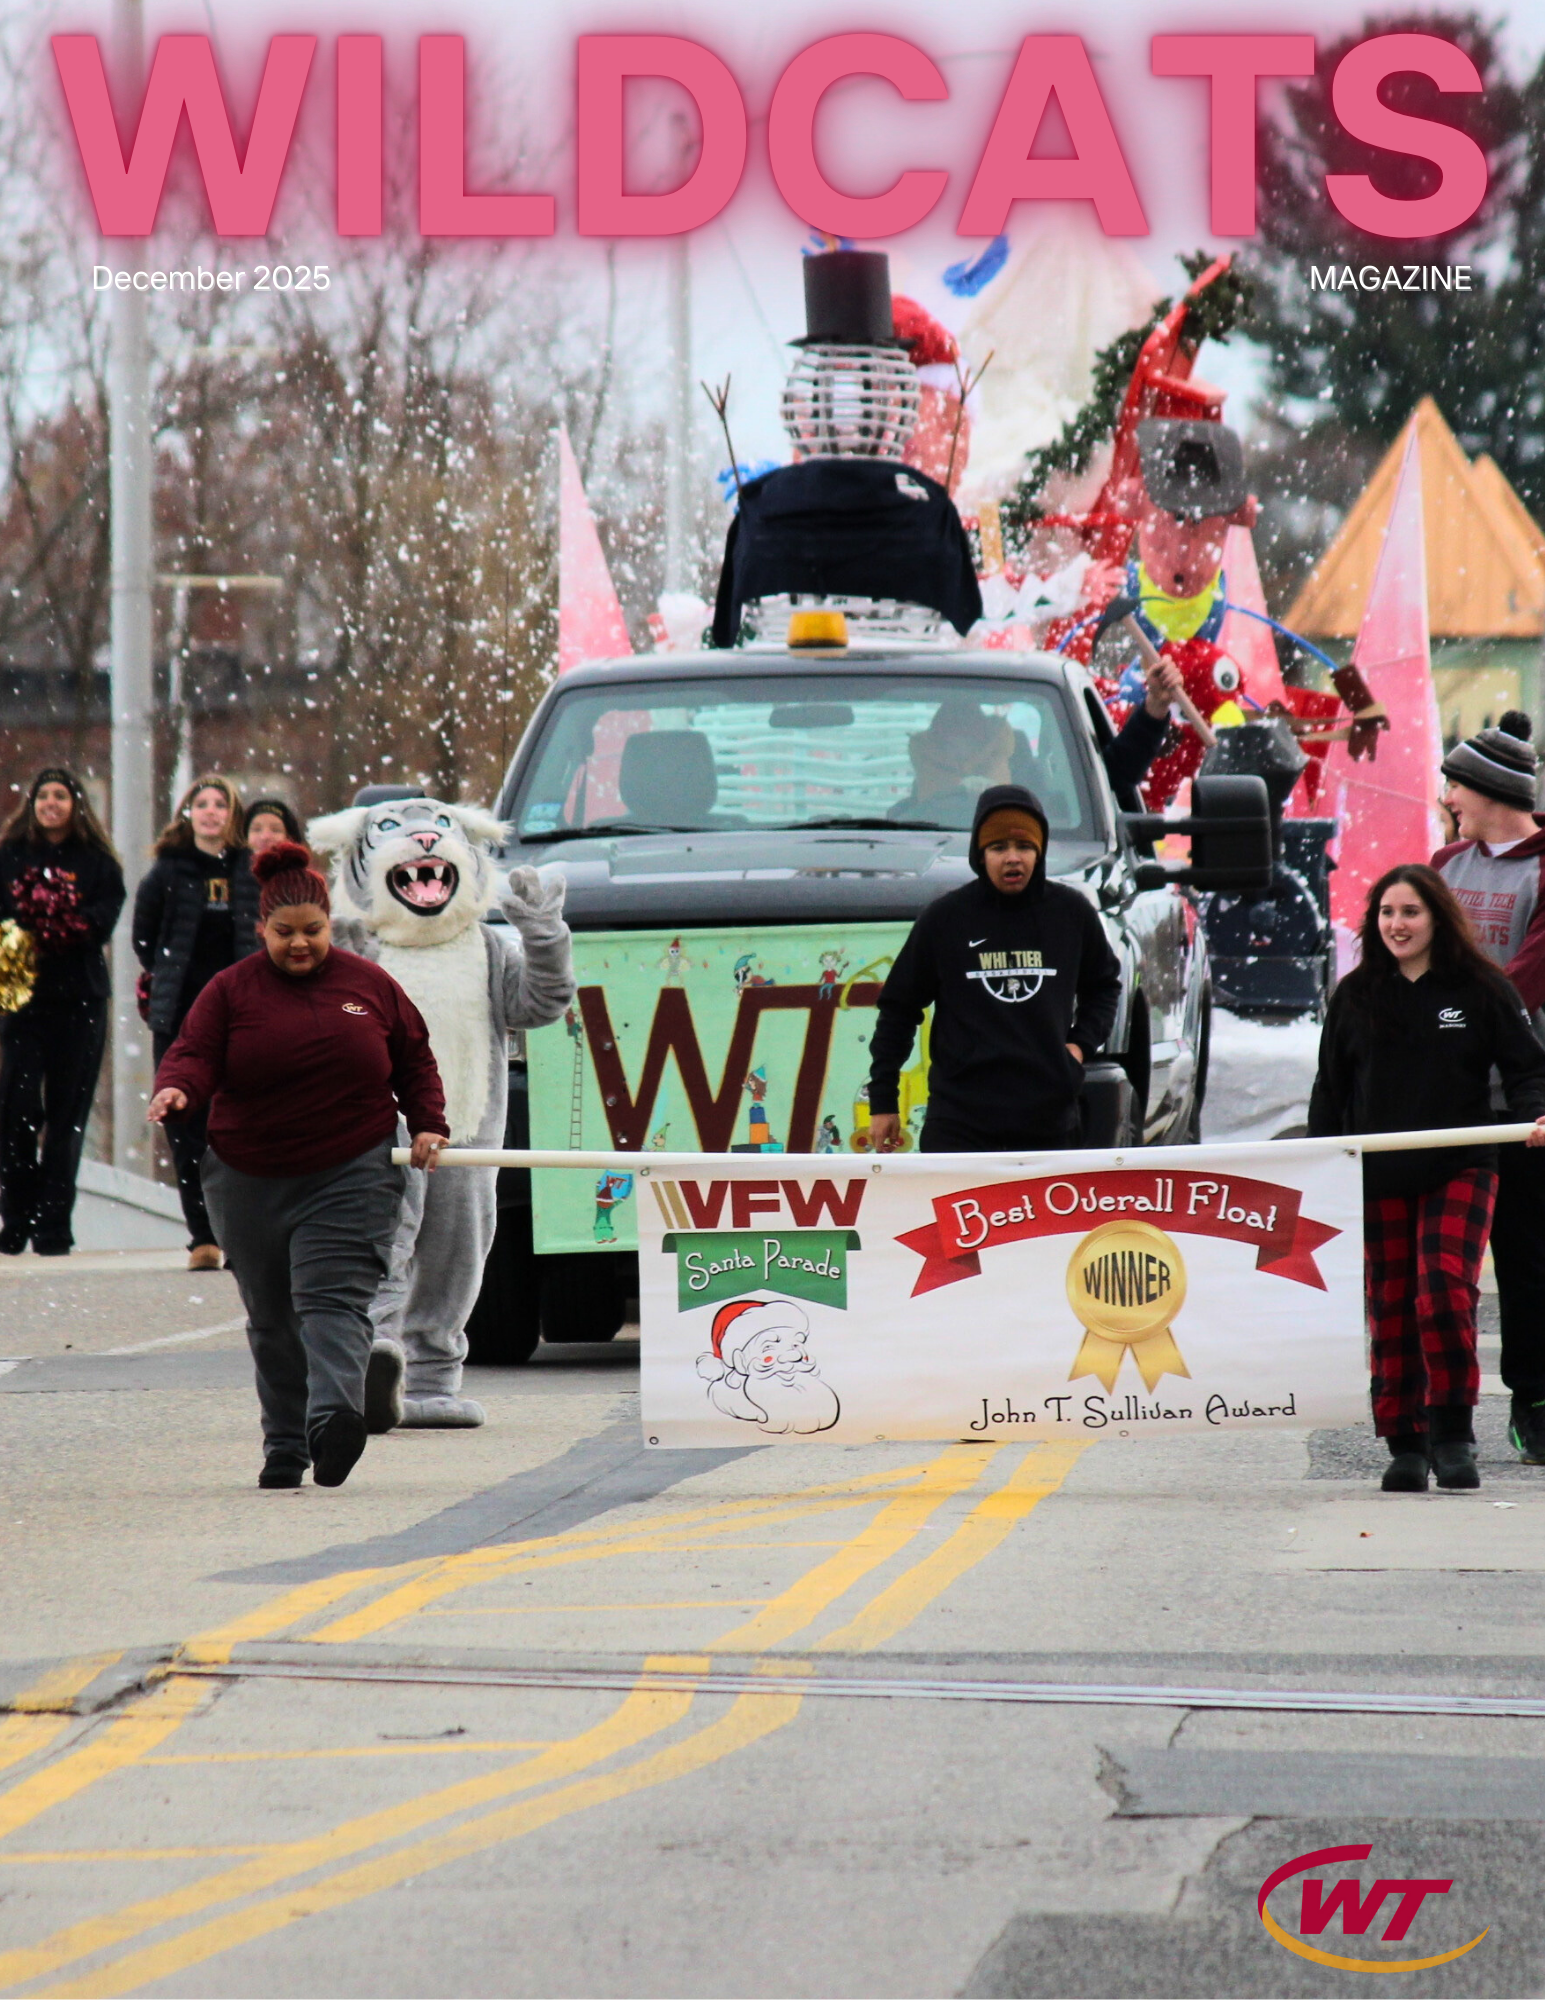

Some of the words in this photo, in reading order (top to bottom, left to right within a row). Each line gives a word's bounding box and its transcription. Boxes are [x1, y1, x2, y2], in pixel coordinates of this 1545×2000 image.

[979, 950, 1043, 969] WHITIER
[1443, 1010, 1463, 1019] WT
[577, 982, 887, 1154] WT
[678, 1178, 868, 1230] VFW
[952, 1195, 1036, 1248] Best
[1044, 1178, 1174, 1214] Overall
[1187, 1181, 1278, 1232] Float
[685, 1248, 757, 1291] Santa
[763, 1238, 841, 1280] Parade
[1083, 1250, 1172, 1307] WINNER
[970, 1398, 1036, 1431] John
[1044, 1396, 1072, 1423] T.
[1083, 1395, 1193, 1428] Sullivan
[1205, 1393, 1297, 1425] Award
